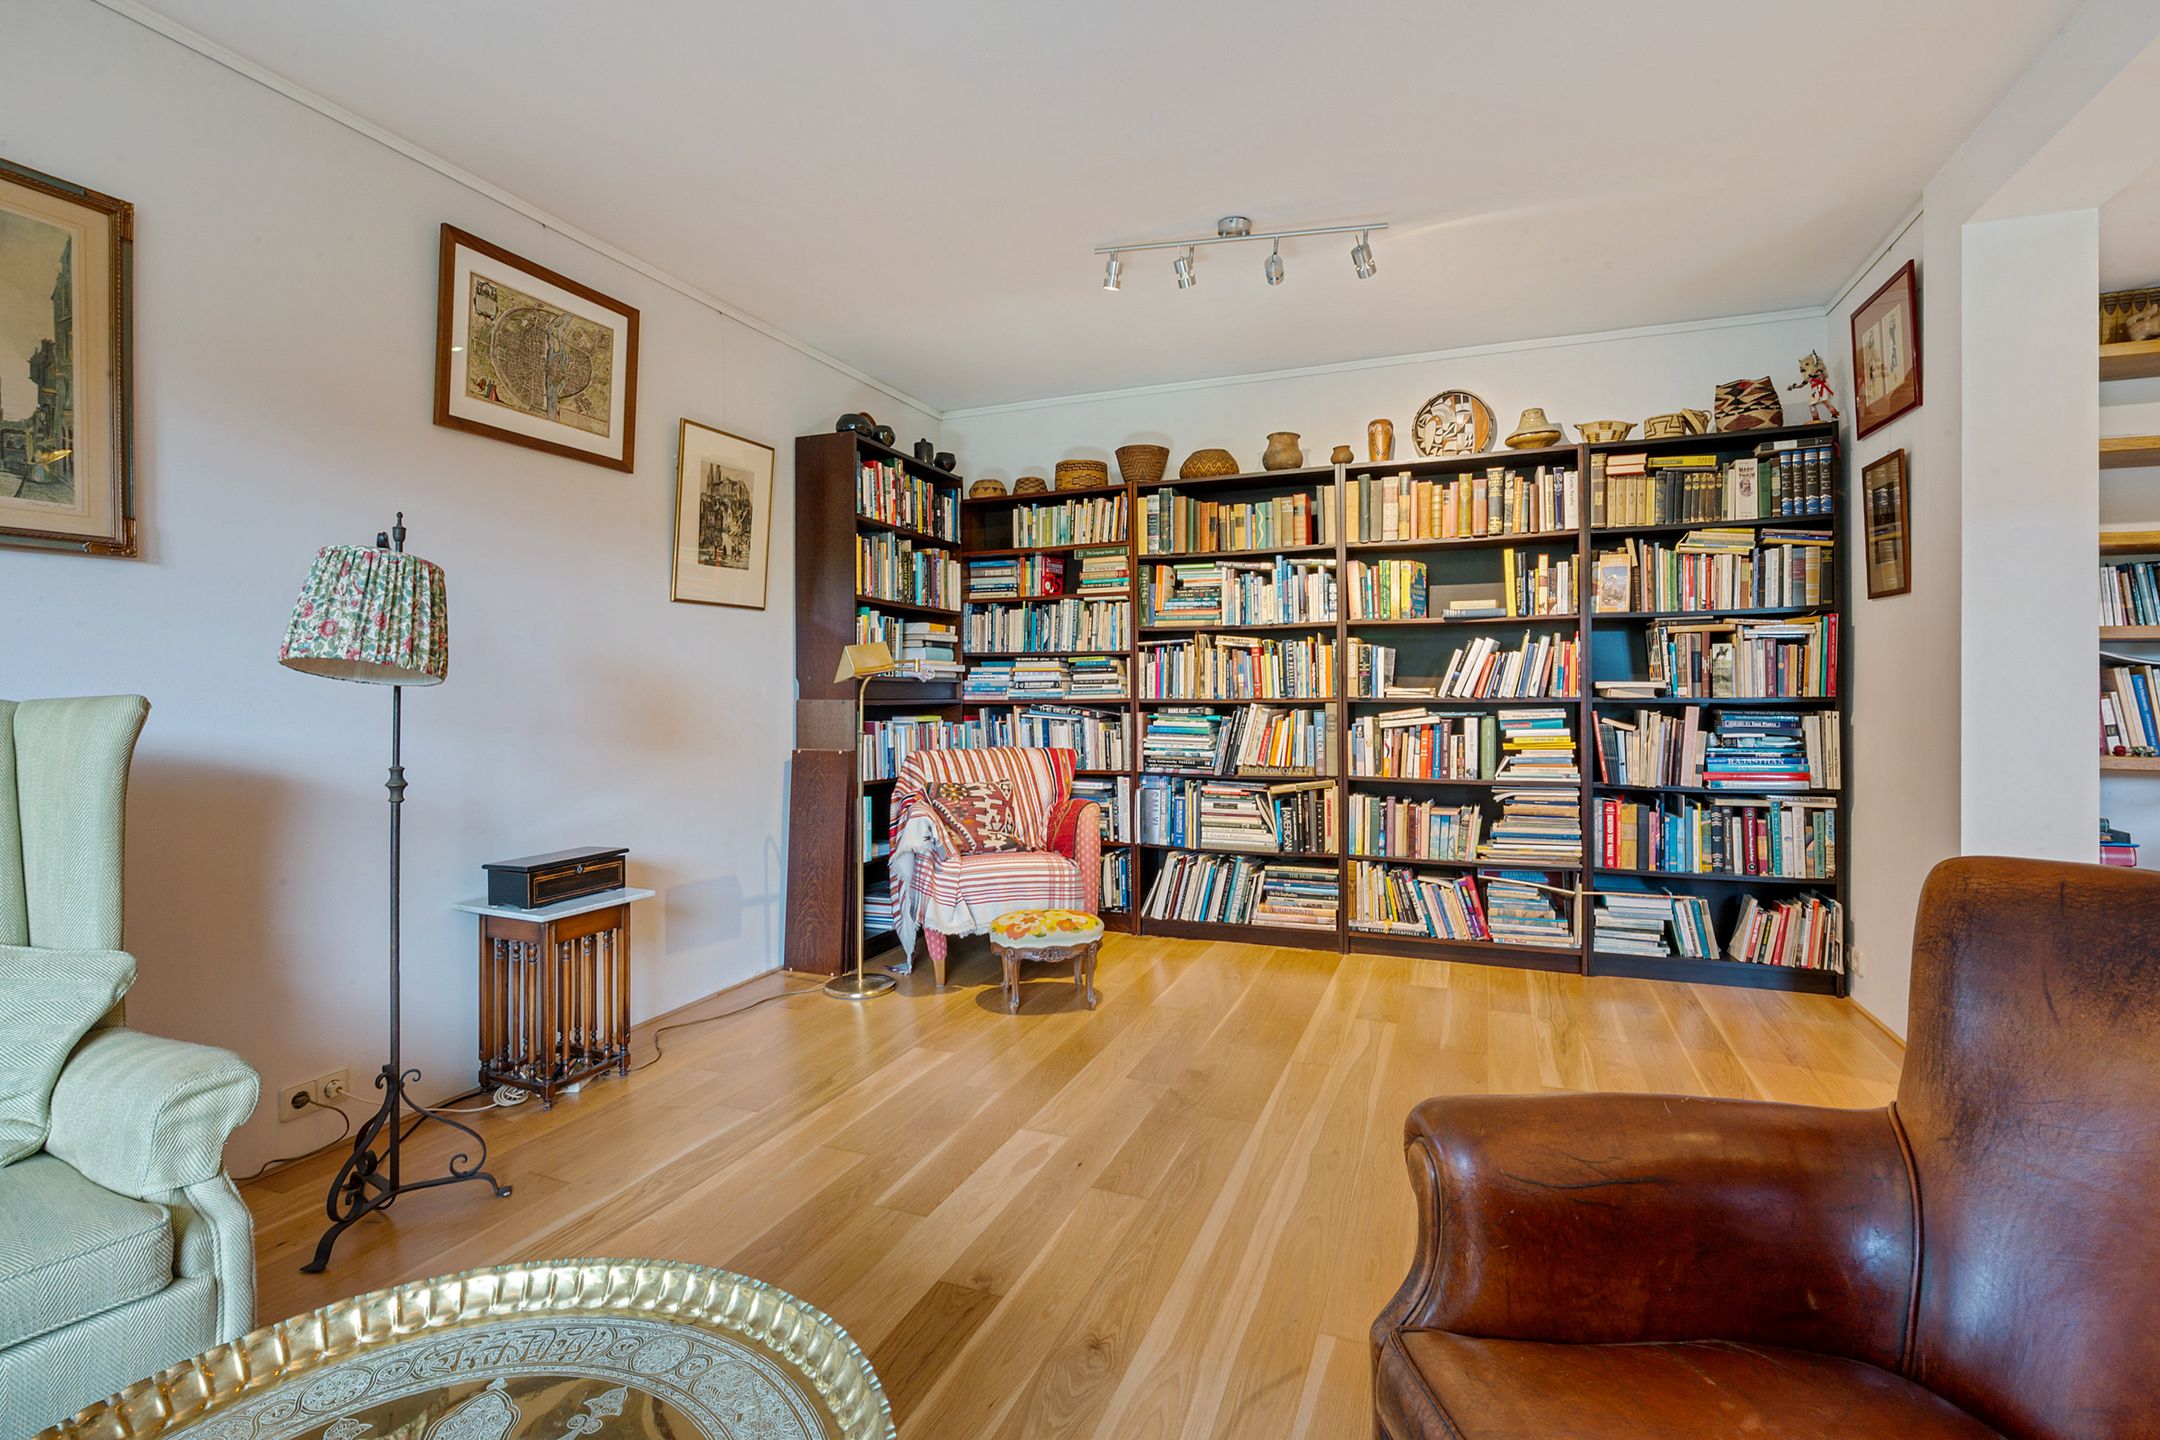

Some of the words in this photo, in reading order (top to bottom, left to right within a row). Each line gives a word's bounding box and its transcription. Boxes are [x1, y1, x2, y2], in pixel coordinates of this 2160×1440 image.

[1316, 726, 1325, 760] COLOUR
[1727, 757, 1785, 765] RAJASTHAN
[1283, 810, 1293, 850] AMERICAN
[1606, 814, 1614, 834] BEHIND
